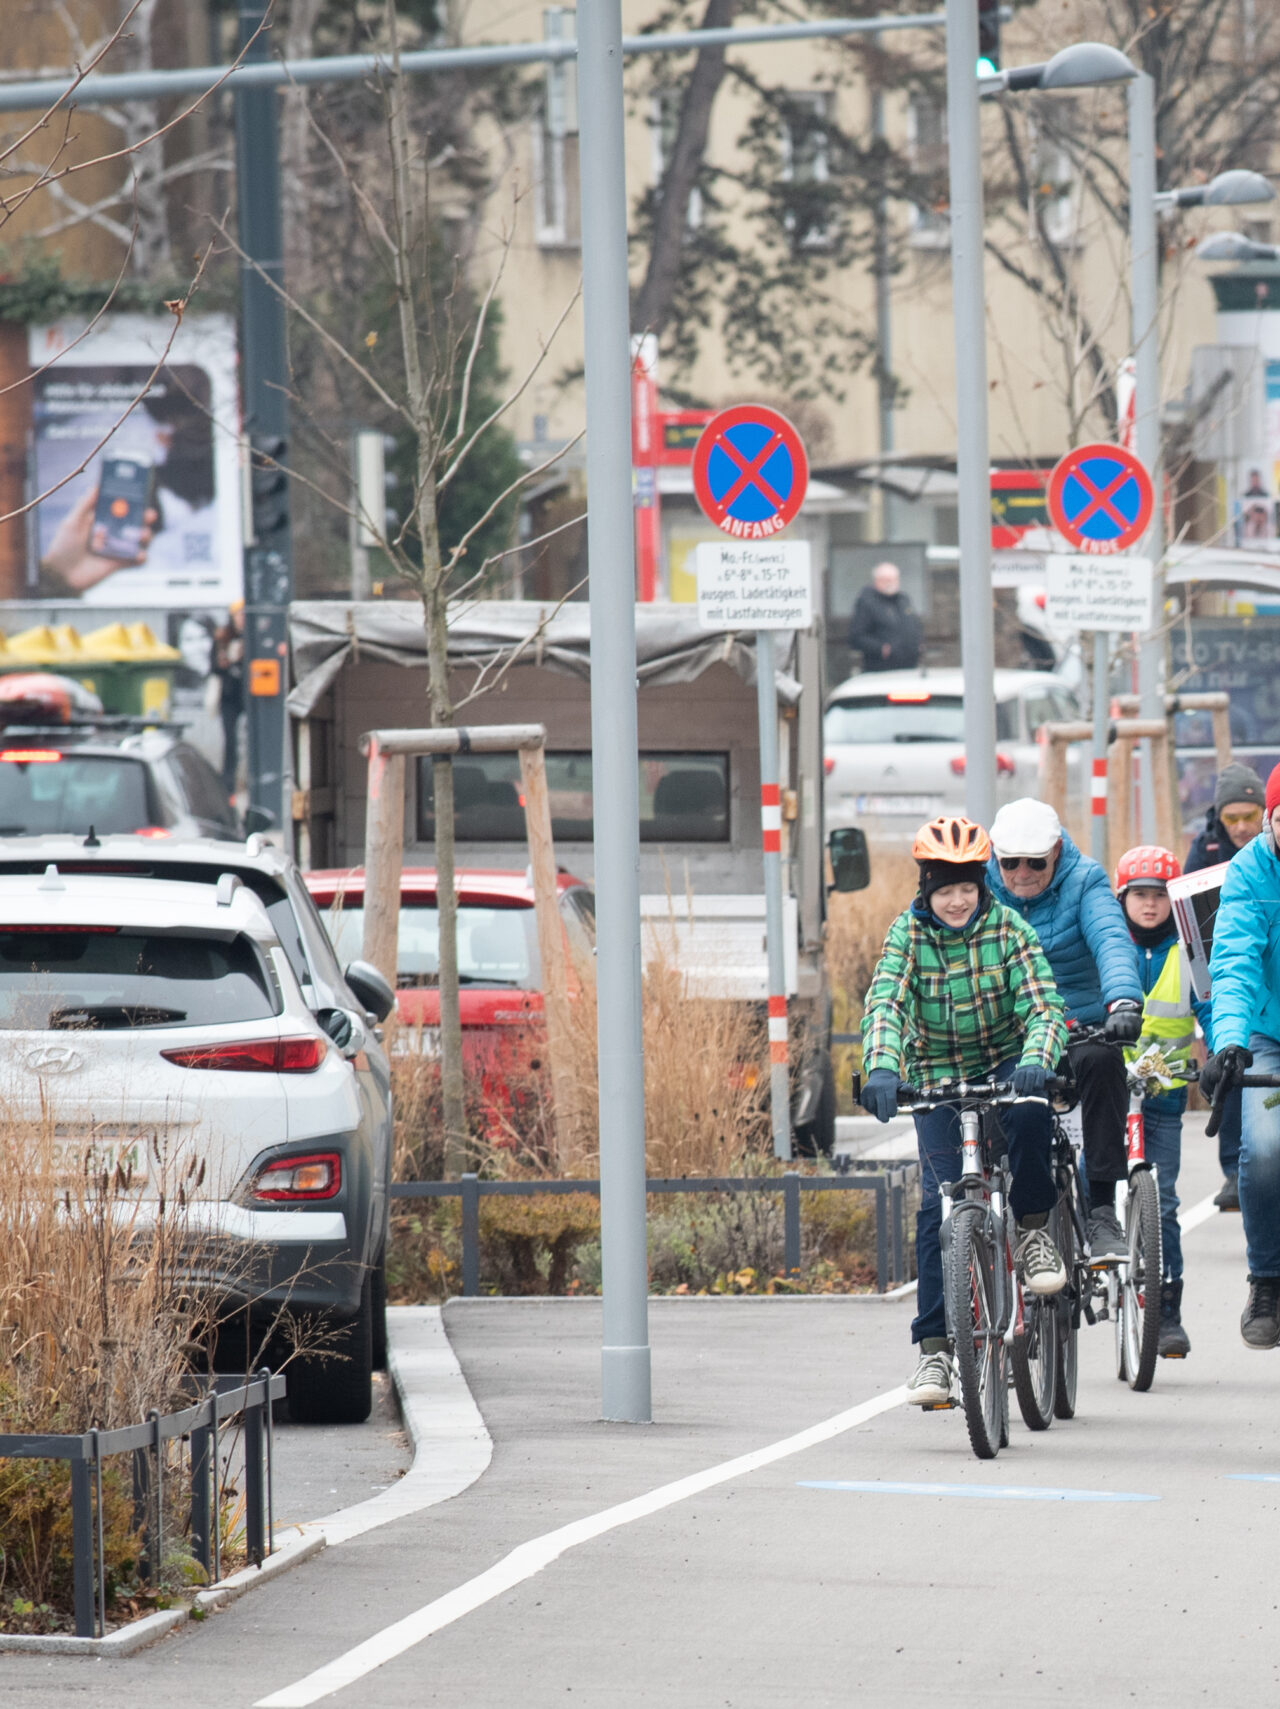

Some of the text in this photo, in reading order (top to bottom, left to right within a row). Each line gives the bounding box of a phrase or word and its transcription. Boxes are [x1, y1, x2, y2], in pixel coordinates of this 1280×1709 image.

[720, 514, 785, 539] ANFANG
[1079, 537, 1120, 556] ENDE
[701, 586, 808, 603] ausgen. Ladetätigkeit
[1087, 595, 1148, 608] Ladetätigkeit
[707, 606, 803, 621] mit Lastfahrzeugen
[1054, 610, 1142, 623] mit Lastfahrzeugen
